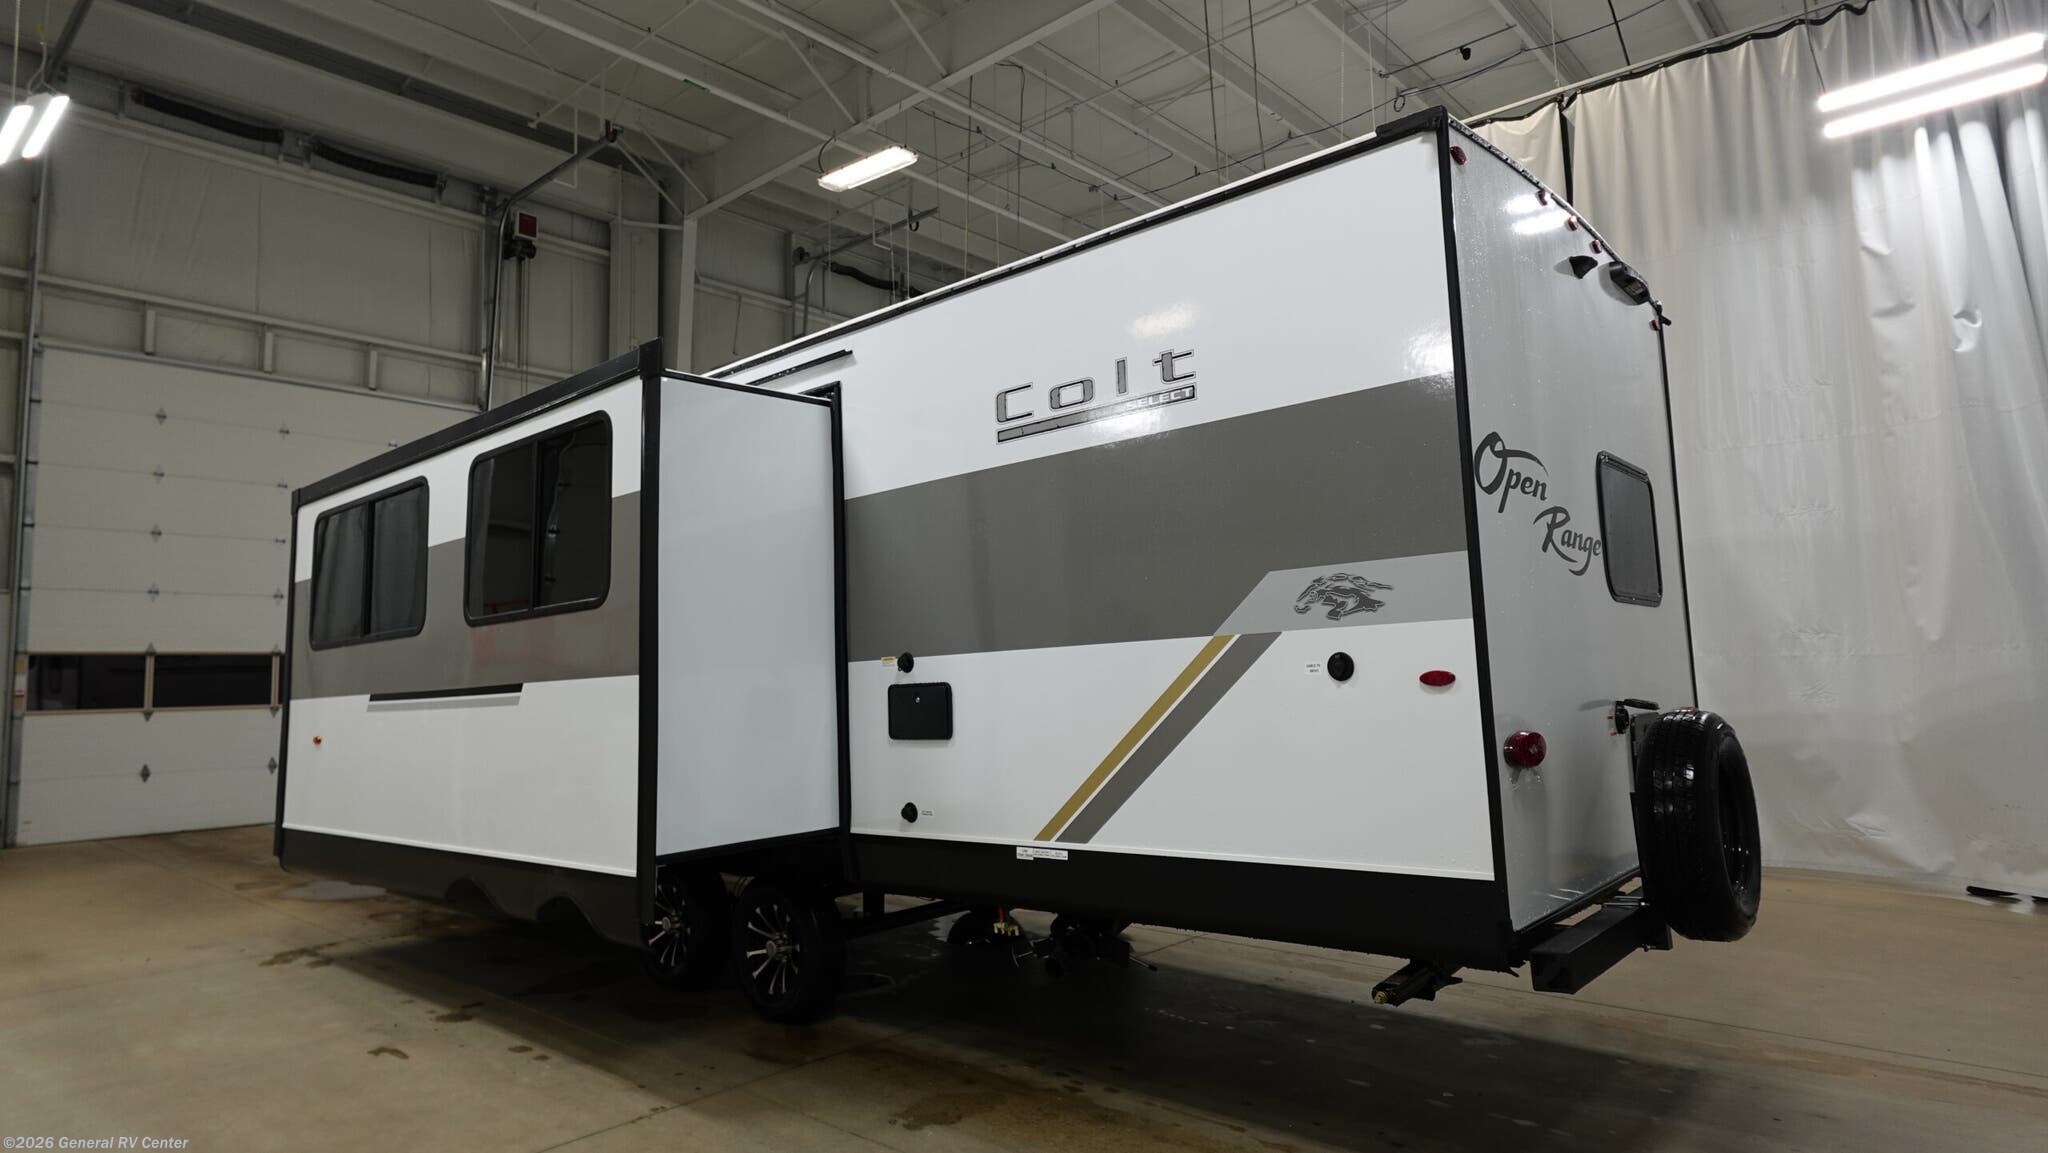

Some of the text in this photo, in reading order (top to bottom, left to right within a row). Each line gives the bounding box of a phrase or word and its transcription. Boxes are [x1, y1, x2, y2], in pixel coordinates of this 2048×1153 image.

[996, 348, 1196, 423] Colt
[1126, 386, 1193, 411] SELECT
[1474, 431, 1549, 513] Open
[1533, 506, 1602, 576] Range
